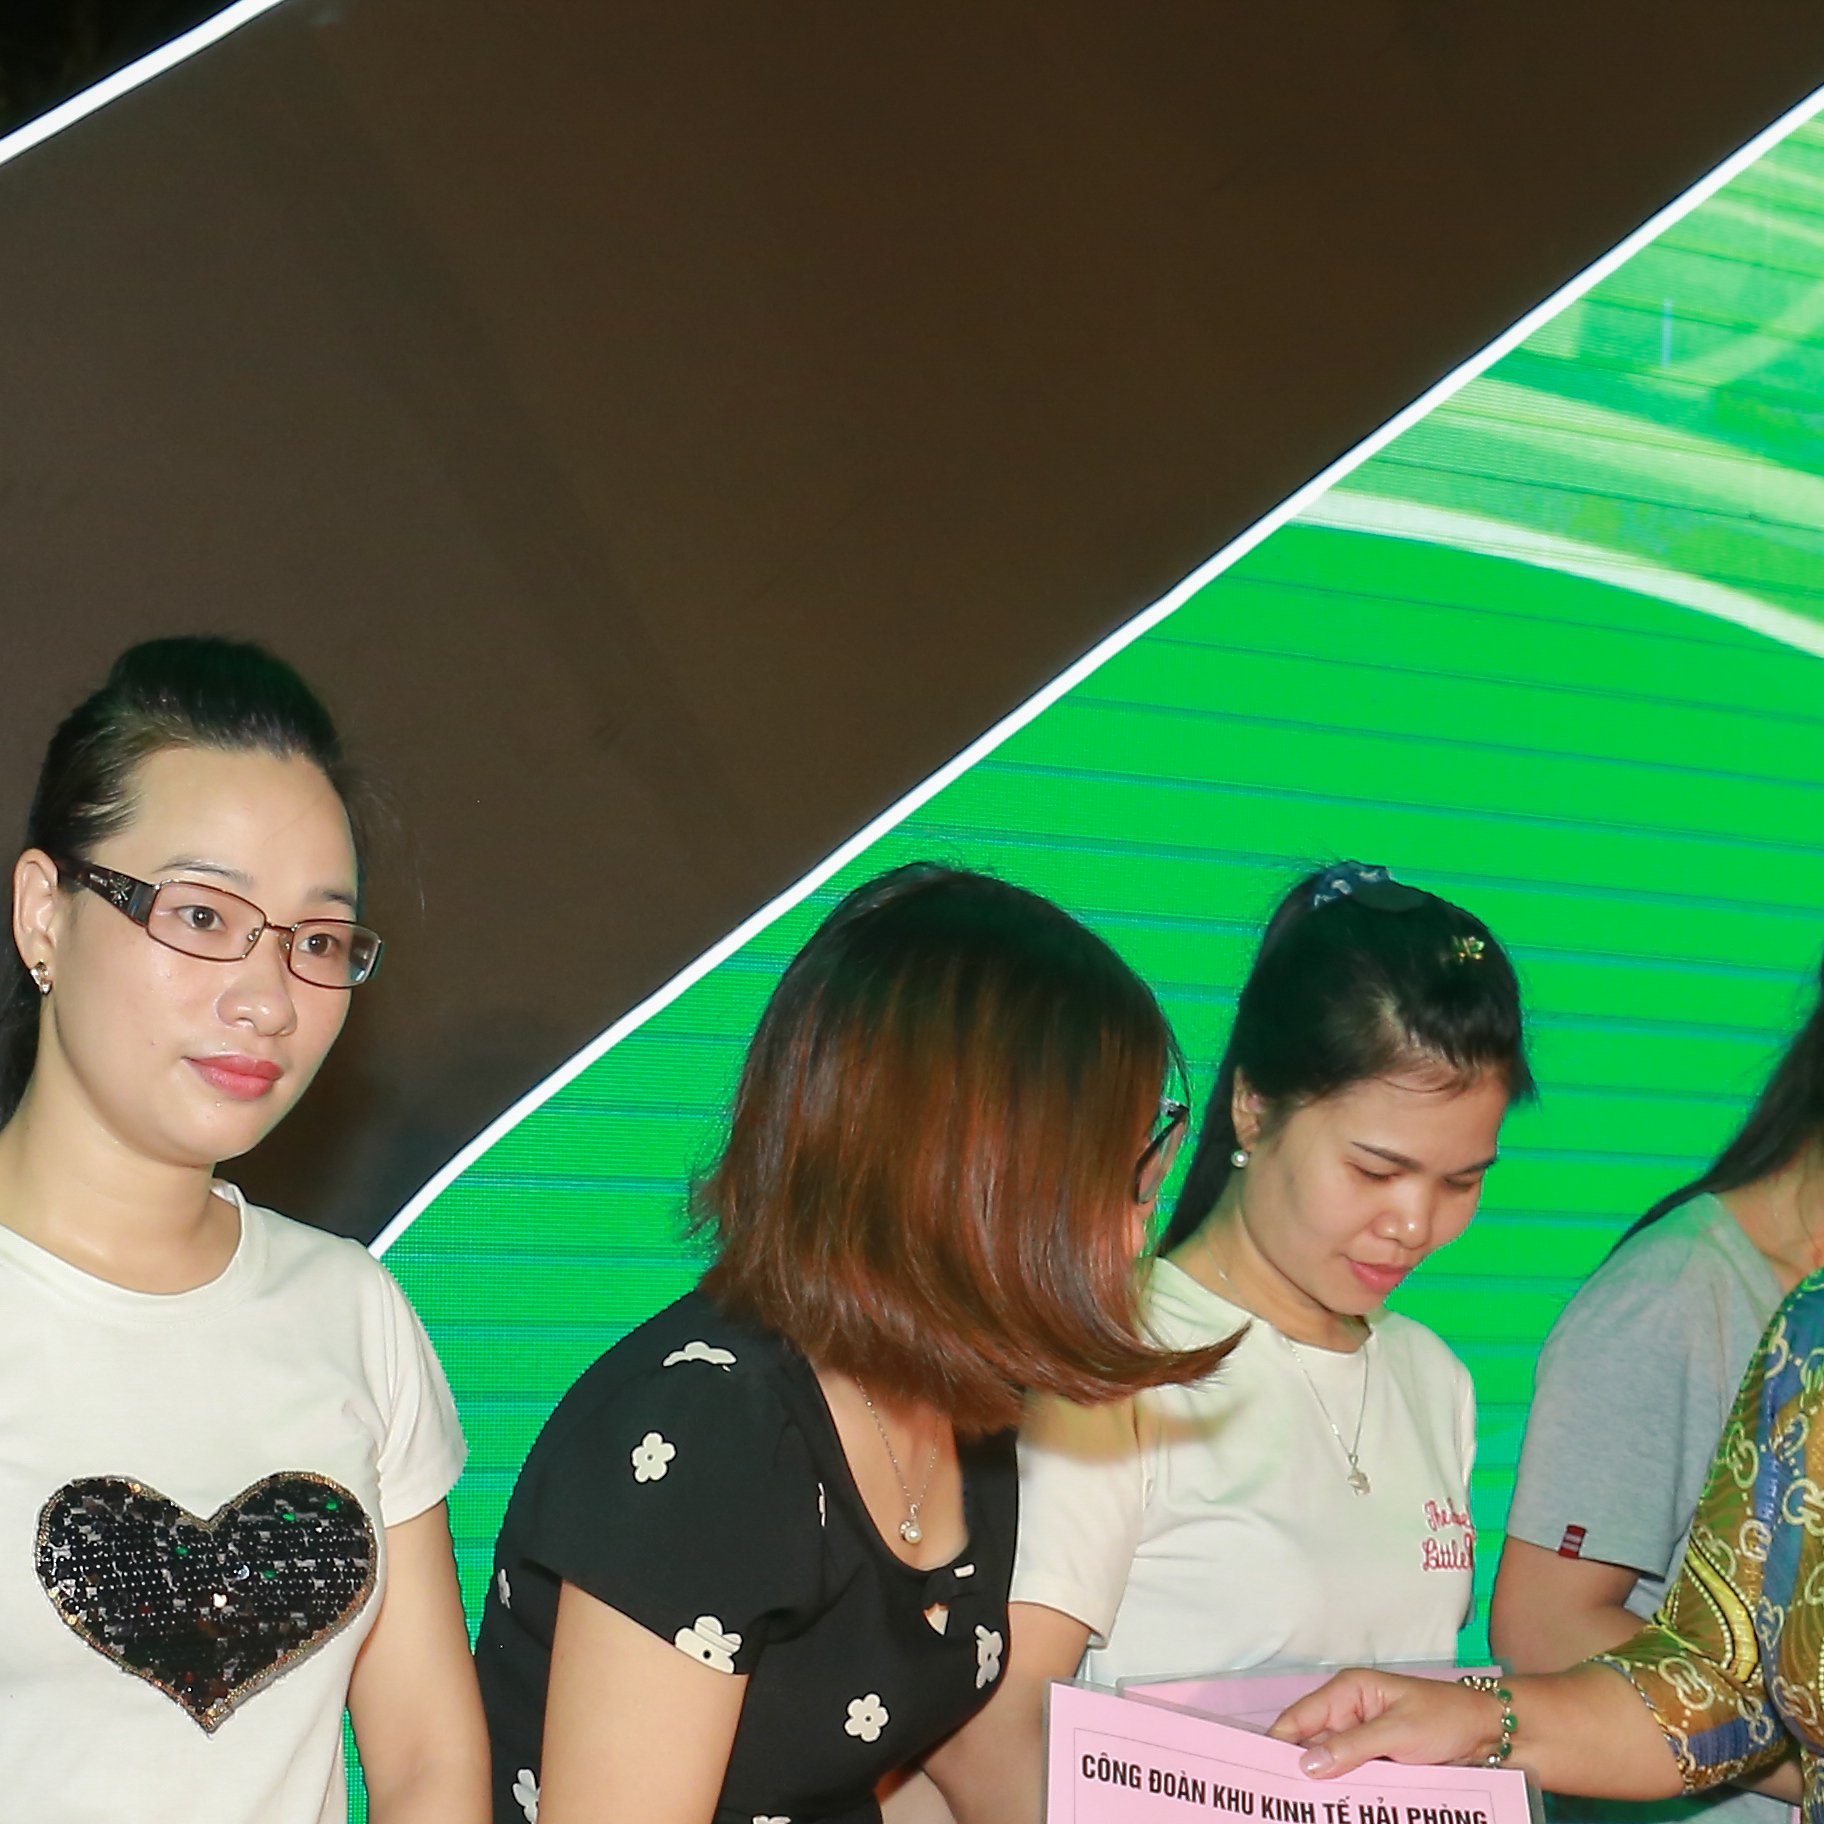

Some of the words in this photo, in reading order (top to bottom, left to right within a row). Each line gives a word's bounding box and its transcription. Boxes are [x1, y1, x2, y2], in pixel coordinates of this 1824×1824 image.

[1081, 1753, 1142, 1790] CÔNG
[1148, 1772, 1206, 1805] ĐOÀN
[1213, 1783, 1255, 1817] KHU
[1261, 1795, 1316, 1824] KINH
